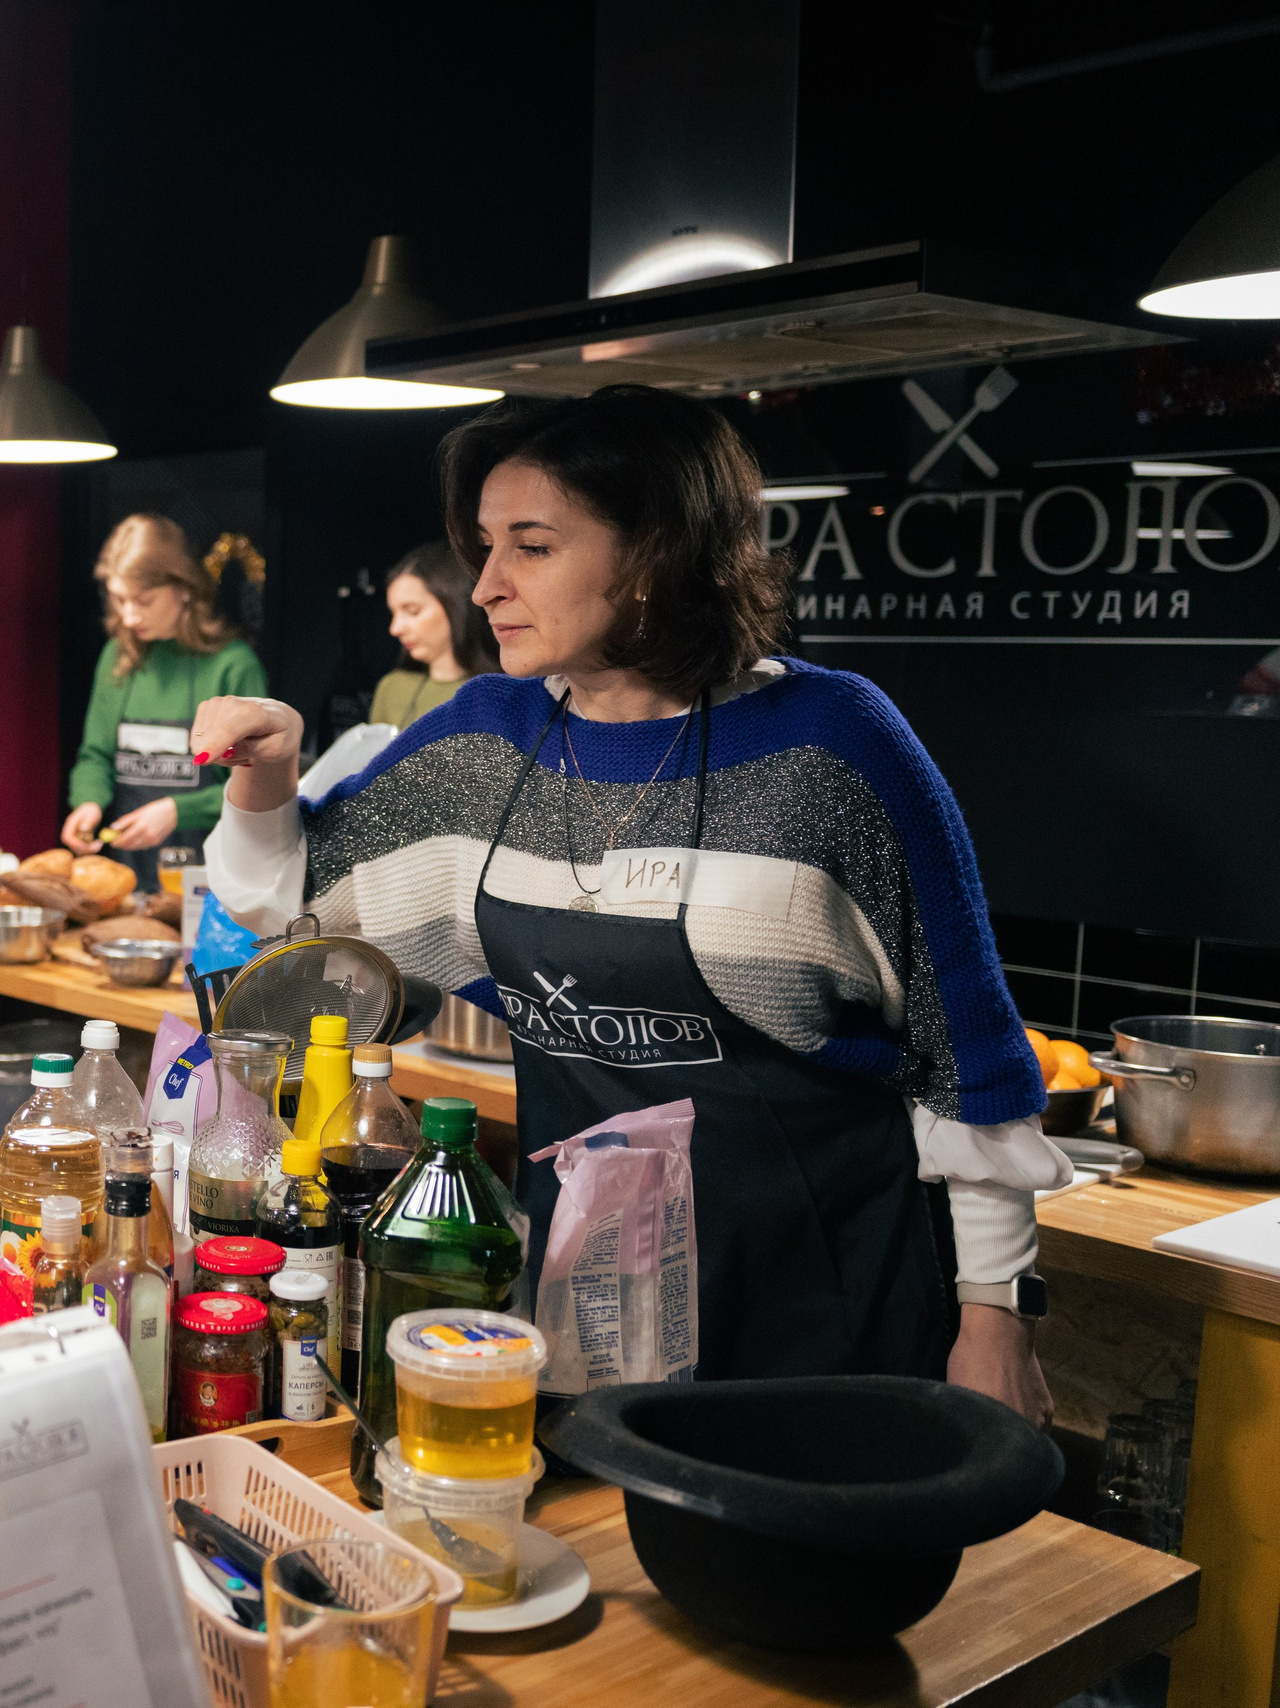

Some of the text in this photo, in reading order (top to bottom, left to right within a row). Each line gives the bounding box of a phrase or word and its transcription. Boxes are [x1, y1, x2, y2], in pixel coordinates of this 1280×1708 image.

[760, 476, 1280, 581] РА СТОЛО
[797, 589, 1190, 625] ИНАРНАЯ СТУДИЯ
[625, 858, 680, 889] ИРА
[499, 990, 706, 1046] РА СТОЛОВ
[598, 1048, 662, 1061] СТУДИЯ
[168, 1073, 184, 1090] Chef
[189, 1180, 219, 1198] STELLO
